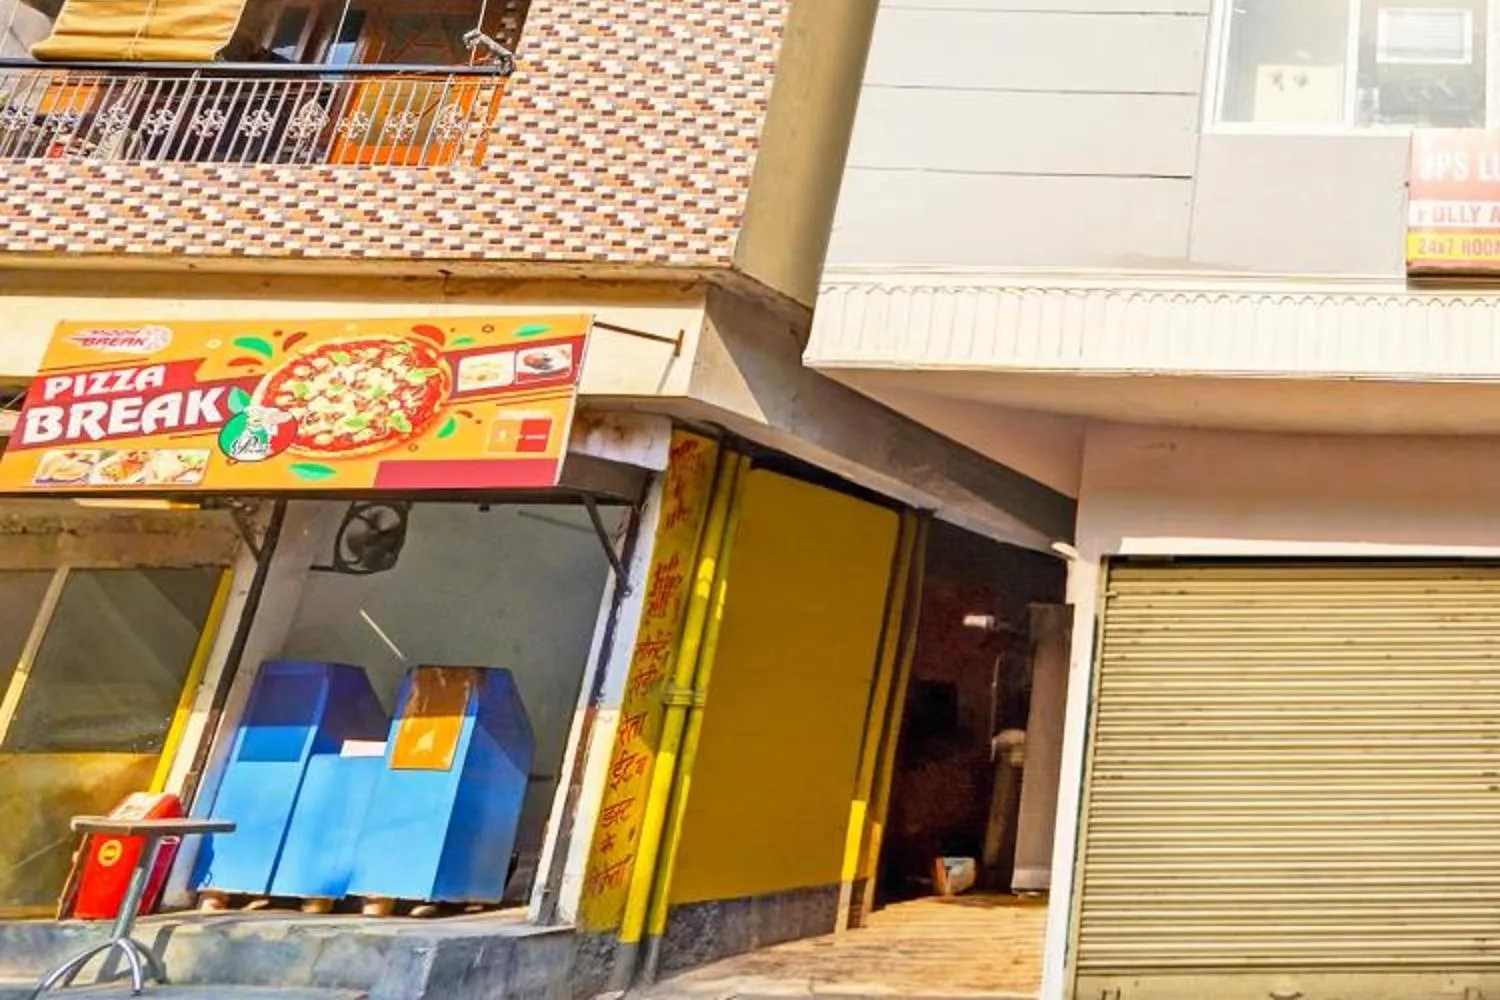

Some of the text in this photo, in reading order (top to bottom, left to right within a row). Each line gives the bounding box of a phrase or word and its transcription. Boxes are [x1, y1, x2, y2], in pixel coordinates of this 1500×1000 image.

[1418, 150, 1470, 182] JPS
[1417, 205, 1482, 225] FULLY
[1417, 239, 1454, 256] 24x7
[43, 365, 166, 400] PIZZA
[22, 386, 226, 445] BREAK
